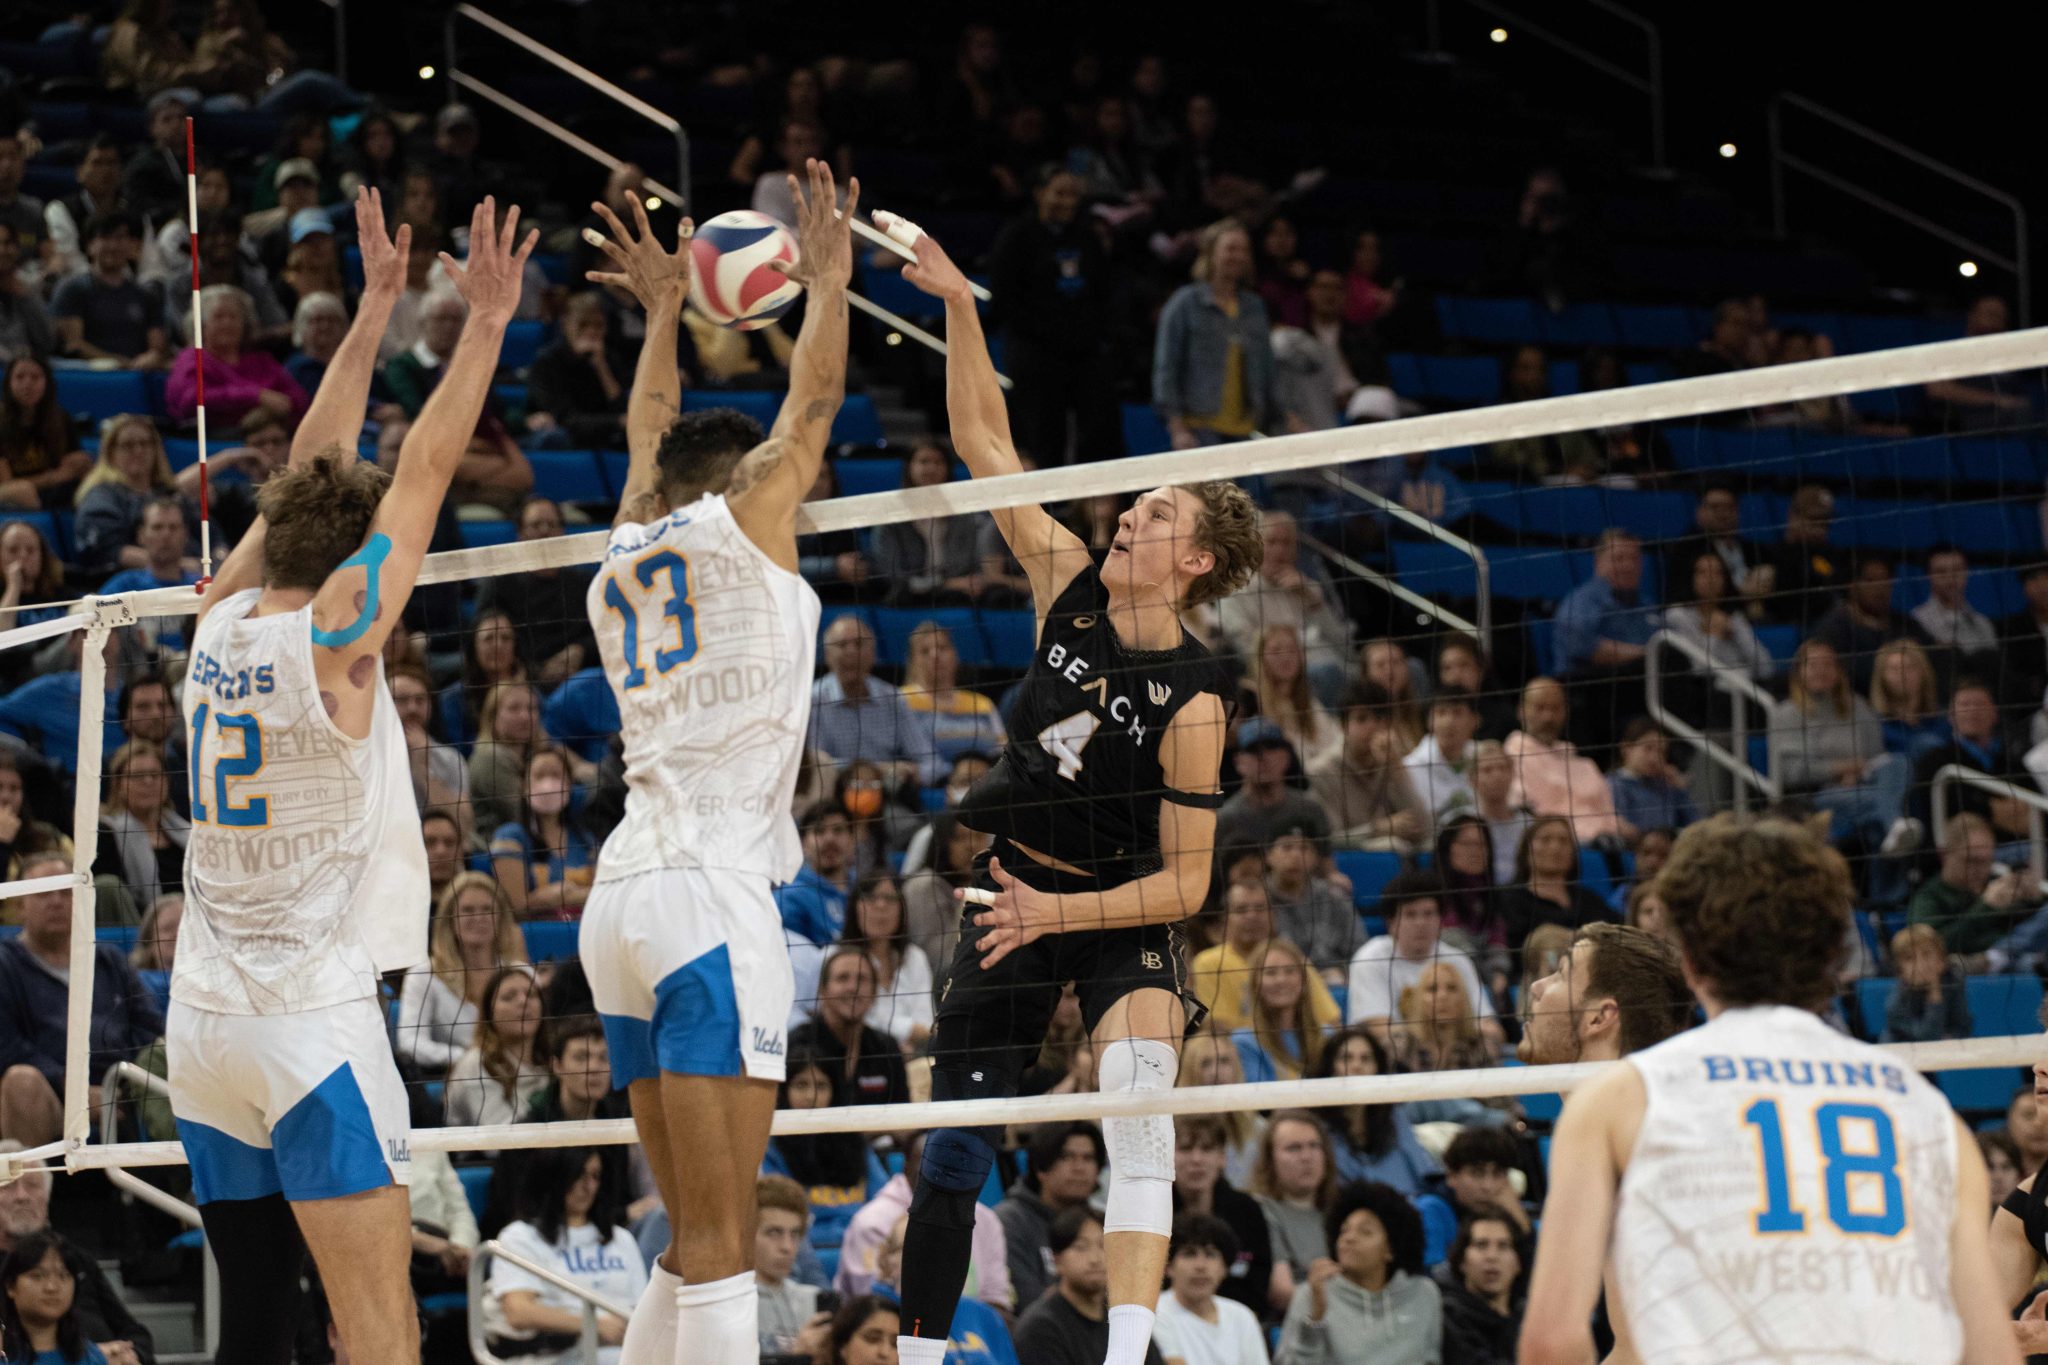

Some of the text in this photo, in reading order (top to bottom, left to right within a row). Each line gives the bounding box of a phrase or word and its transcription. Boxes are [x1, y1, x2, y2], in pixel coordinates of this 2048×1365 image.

[604, 546, 702, 694] 13
[191, 697, 272, 831] 12
[1037, 709, 1103, 782] 4
[1702, 1054, 1909, 1096] BRUINS
[1739, 1096, 1914, 1241] 18
